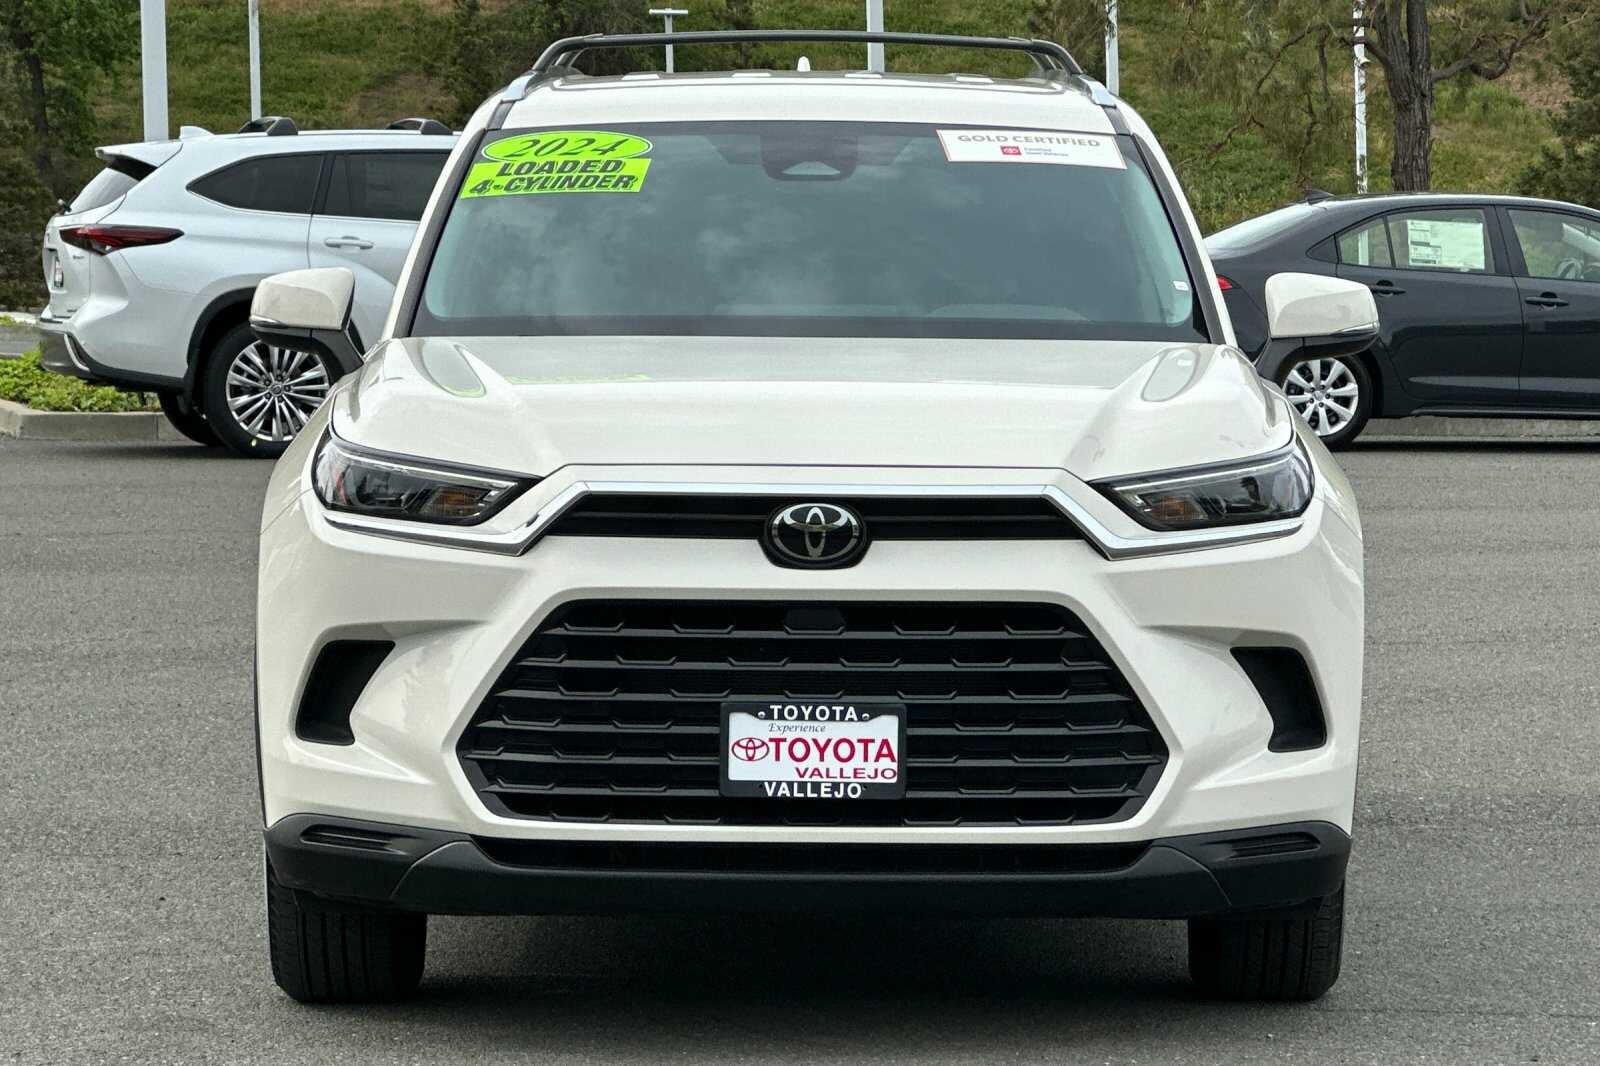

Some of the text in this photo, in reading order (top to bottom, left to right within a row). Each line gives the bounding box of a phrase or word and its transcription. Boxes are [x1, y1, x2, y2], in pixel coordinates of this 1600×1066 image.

[503, 138, 629, 157] 2024
[957, 134, 1101, 147] GOLD CERTIFIED
[496, 159, 626, 177] LOADED
[469, 174, 638, 194] 4-CYLINDER
[770, 705, 858, 721] TOYOTA
[768, 722, 826, 734] Experience
[768, 737, 897, 763] TOYOTA
[795, 767, 897, 780] VALLEJO
[764, 781, 862, 798] VALLEJO
